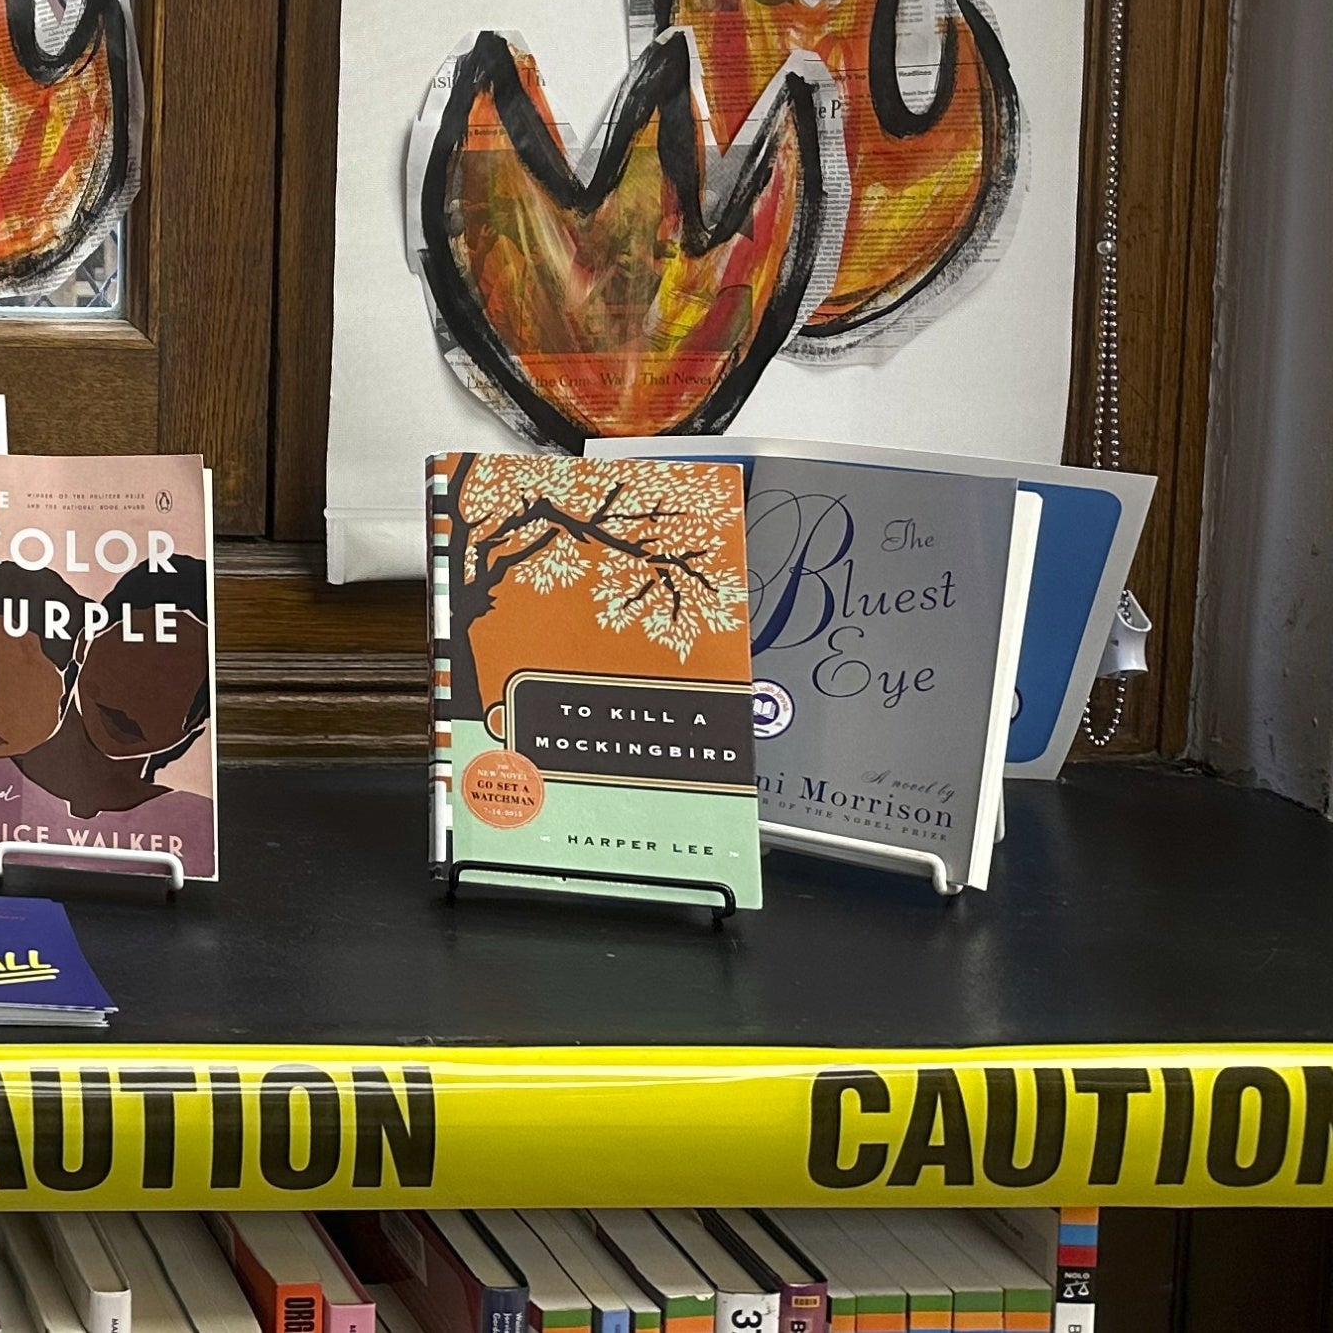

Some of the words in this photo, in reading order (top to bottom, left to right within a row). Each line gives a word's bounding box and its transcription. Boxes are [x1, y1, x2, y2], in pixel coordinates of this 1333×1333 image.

[640, 371, 671, 386] That
[880, 517, 935, 553] The
[746, 489, 958, 658] Bluest
[811, 625, 936, 709] Eye
[560, 704, 592, 718] TO
[610, 707, 675, 724] KILL
[693, 713, 708, 726] A
[535, 736, 738, 763] MOCKINGBIRD
[477, 769, 496, 777] NEW
[500, 771, 529, 781] NOVEL
[477, 779, 493, 789] GO
[496, 782, 519, 792] SET
[523, 785, 530, 793] A
[471, 791, 535, 806] WATCHMAN
[798, 776, 953, 829] Morrison
[892, 778, 935, 795] novel
[937, 782, 957, 804] by
[778, 800, 796, 810] OF
[805, 806, 833, 819] THE
[843, 814, 892, 831] NOBEL
[901, 826, 948, 842] PRIZE
[66, 828, 184, 859] WALKER
[567, 834, 658, 852] HARPER
[673, 843, 715, 857] LEE
[1064, 1272, 1091, 1280] NOLO
